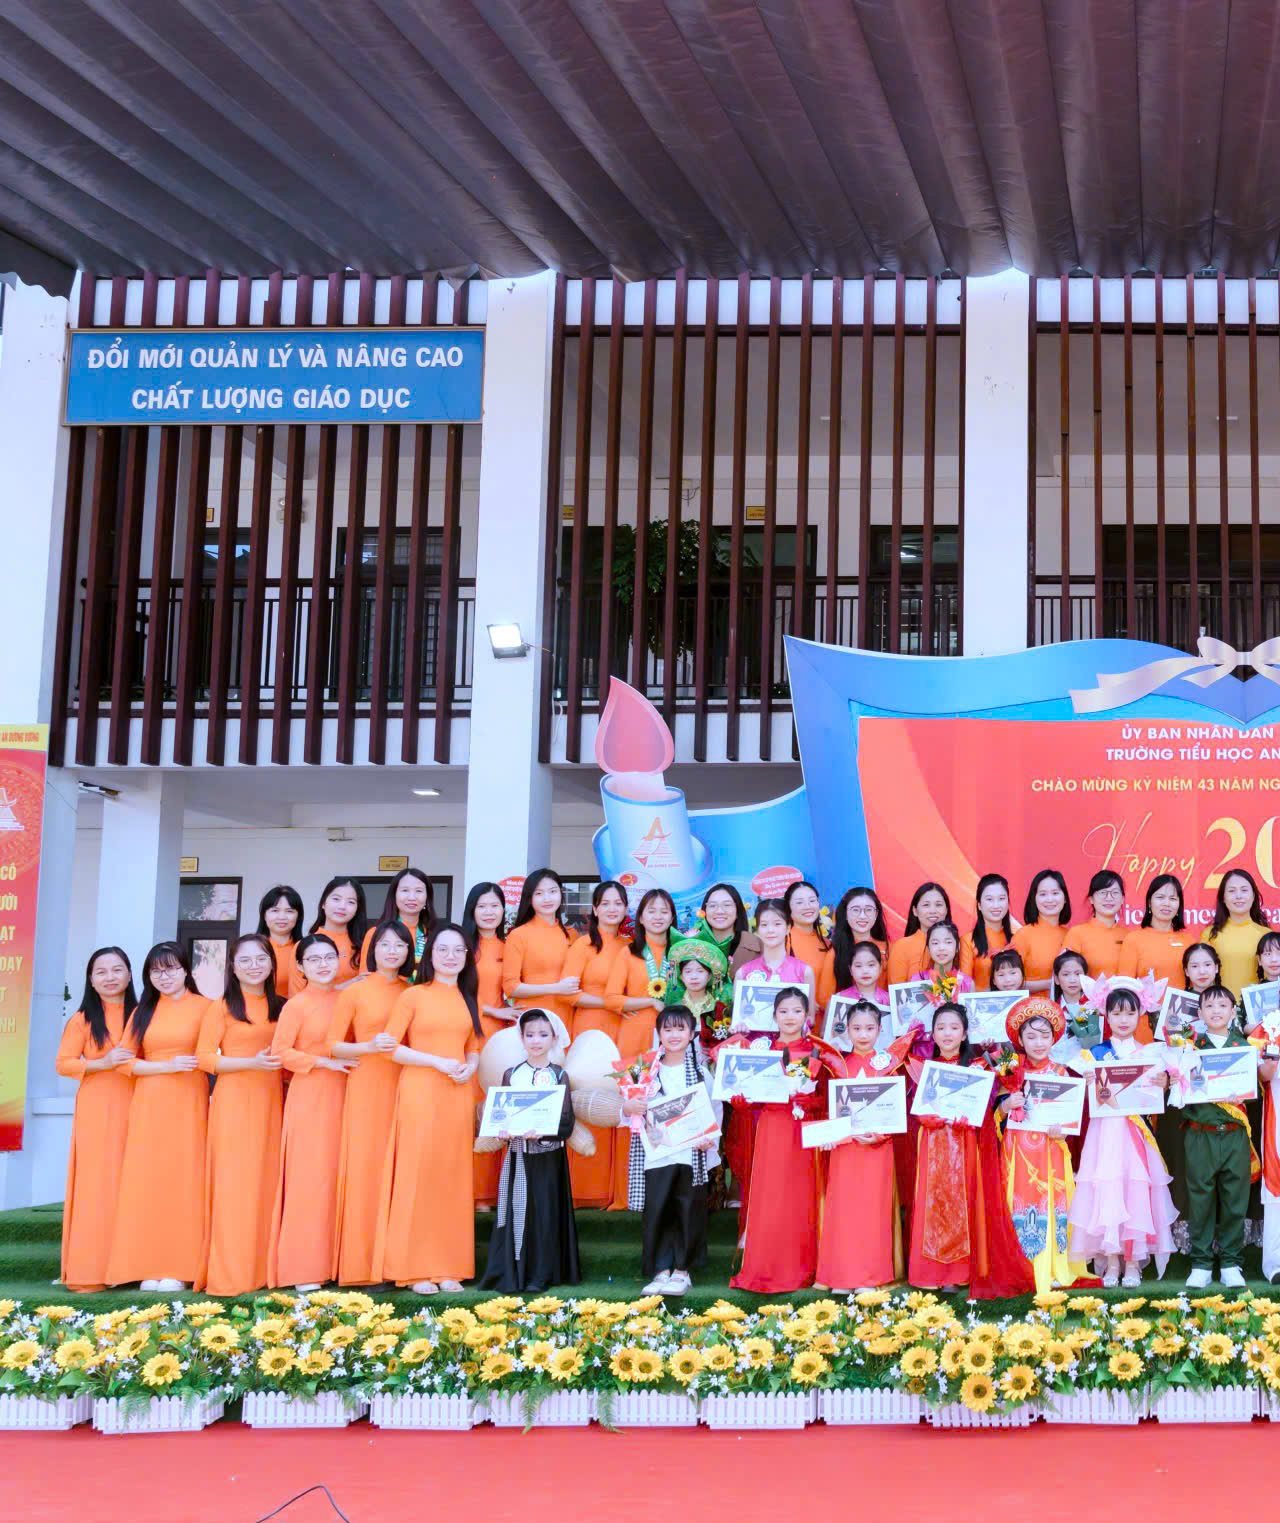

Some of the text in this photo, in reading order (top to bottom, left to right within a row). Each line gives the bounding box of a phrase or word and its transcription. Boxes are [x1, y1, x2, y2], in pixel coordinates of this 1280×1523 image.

[87, 337, 464, 369] ĐỔI MỚI QUẢN LÝ VÀ NÂNG CAO
[131, 381, 411, 414] CHẤT LƯỢNG GIÁO DỤC
[1121, 724, 1142, 740] ỦY
[1147, 727, 1182, 740] BAN
[1187, 725, 1234, 739] NHÂN
[1106, 745, 1174, 761] TRƯỜNG
[1216, 748, 1253, 763] HỌC
[1031, 777, 1077, 792] CHÀO
[1197, 779, 1215, 791] 43
[1082, 812, 1196, 893] Happy
